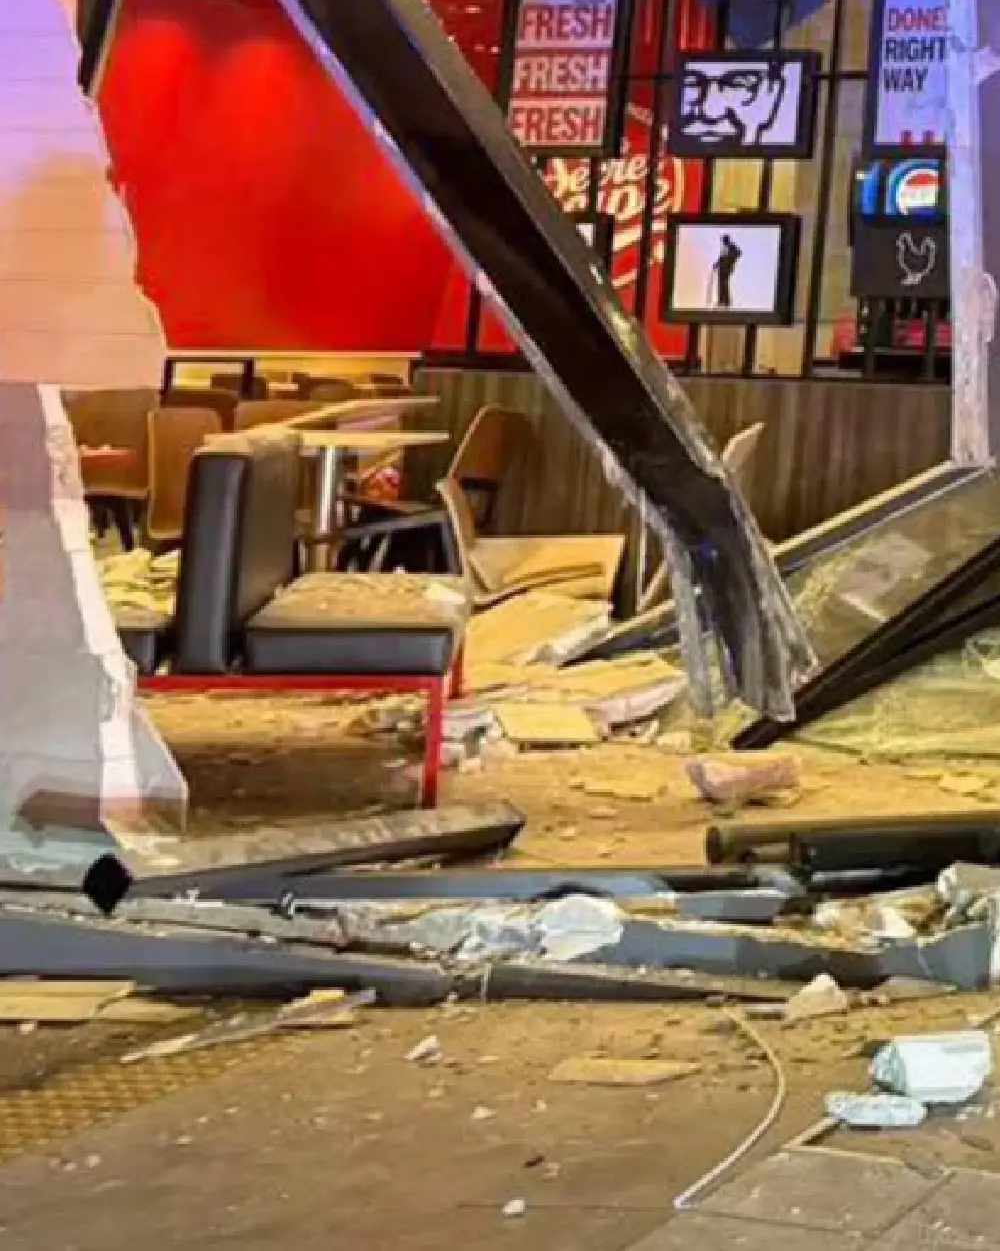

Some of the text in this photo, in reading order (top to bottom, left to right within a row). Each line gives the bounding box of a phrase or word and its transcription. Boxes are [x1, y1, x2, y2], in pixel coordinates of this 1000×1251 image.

[521, 4, 612, 40] FRESH
[885, 36, 946, 62] RIGHT
[514, 54, 608, 91] FRESH
[884, 68, 928, 92] WAY
[511, 107, 601, 141] FRESH
